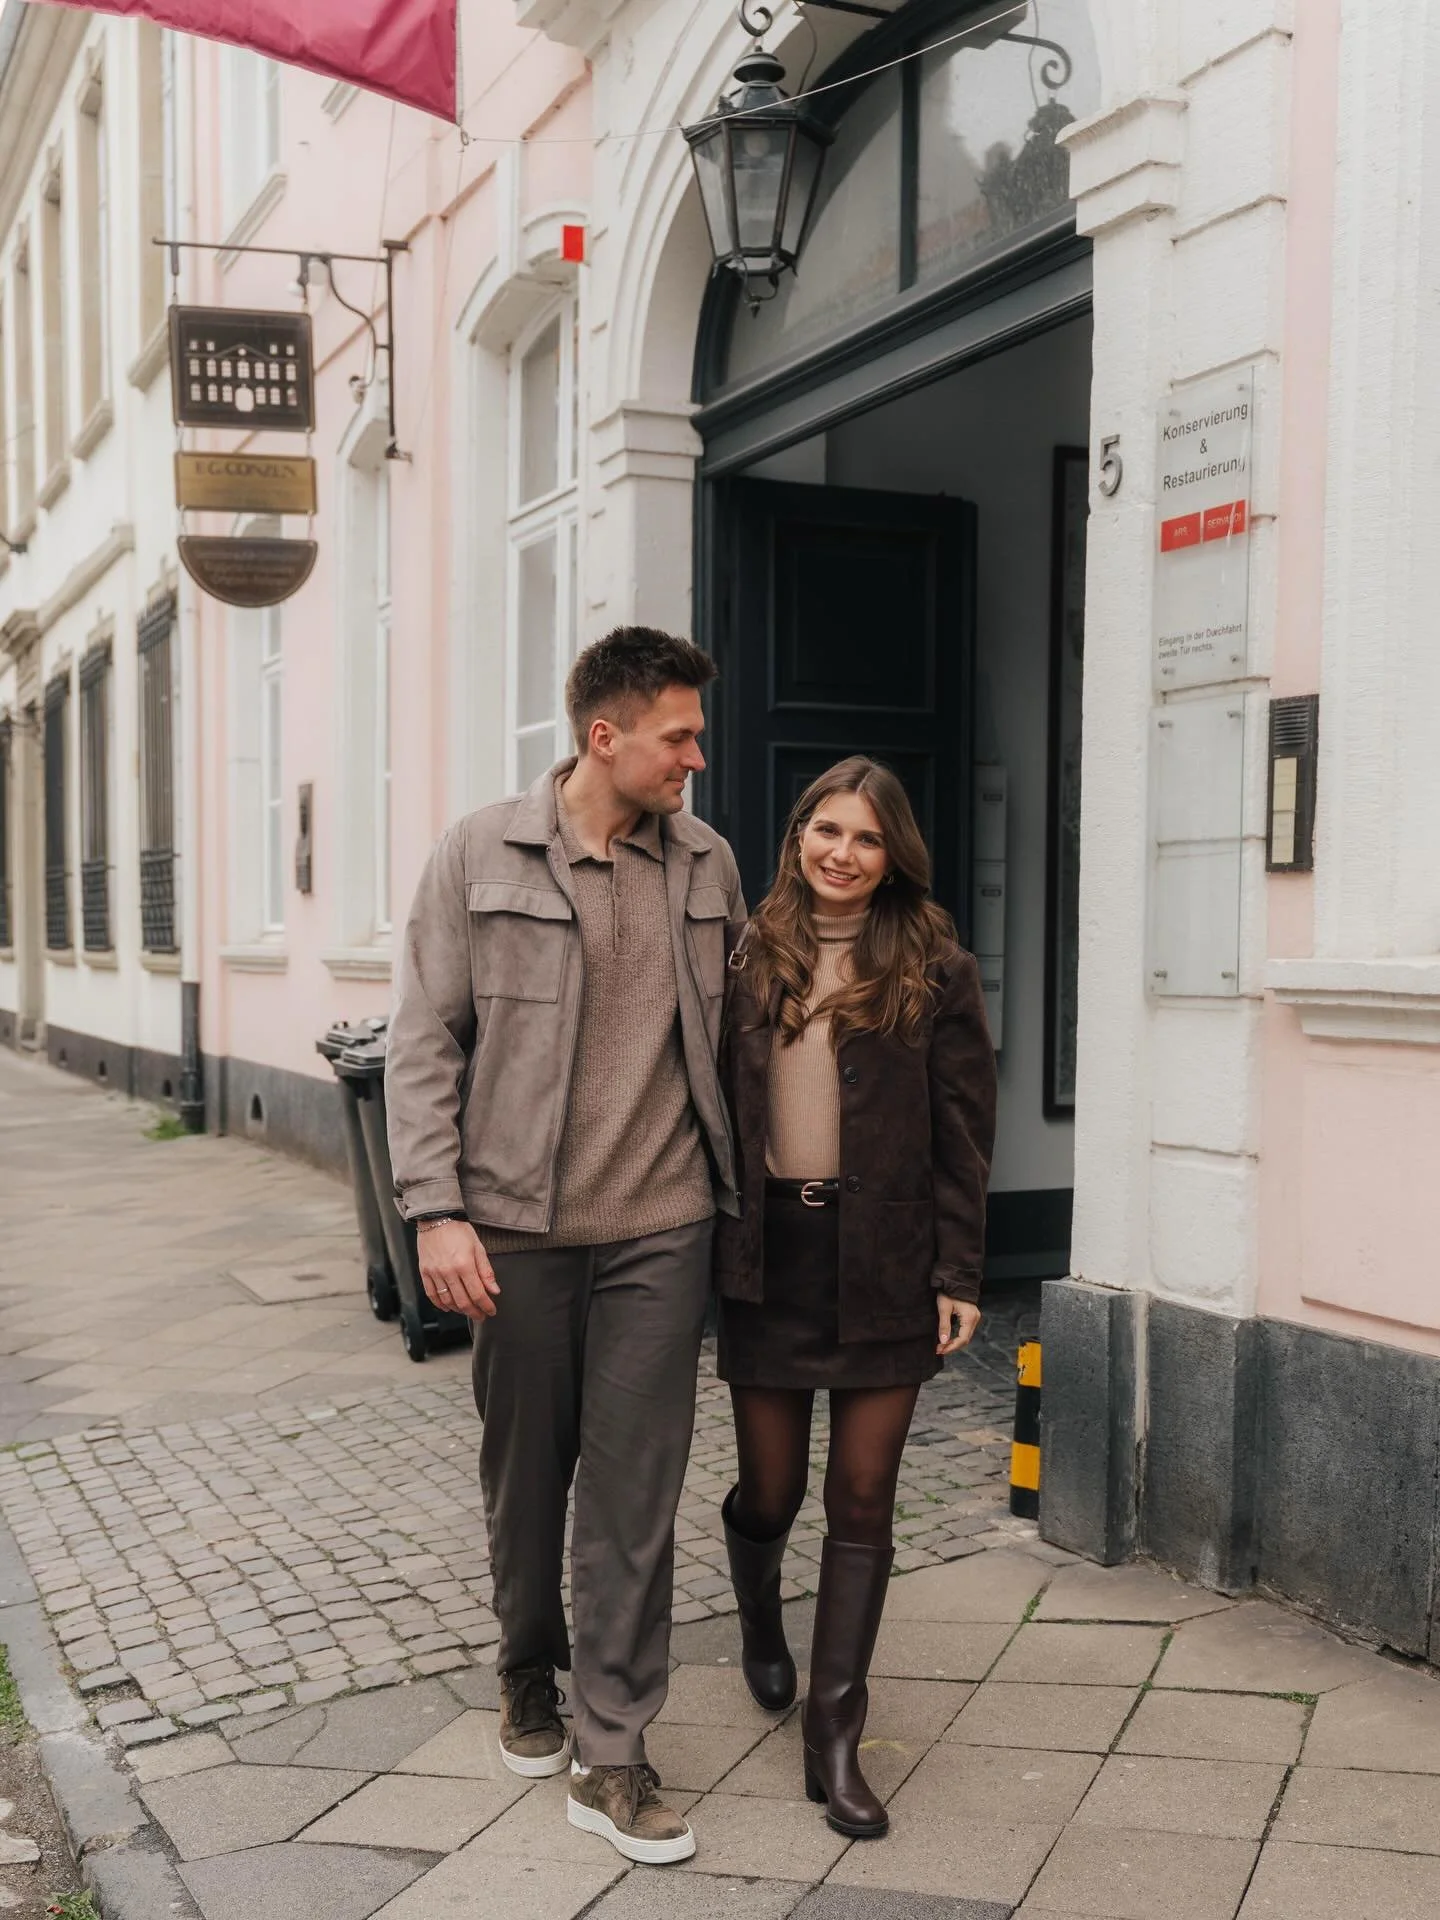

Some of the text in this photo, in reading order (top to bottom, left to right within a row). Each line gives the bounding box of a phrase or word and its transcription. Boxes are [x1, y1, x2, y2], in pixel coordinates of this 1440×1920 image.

[1163, 403, 1248, 441] Konservierung
[1098, 434, 1123, 496] 5
[1200, 438, 1208, 454] &
